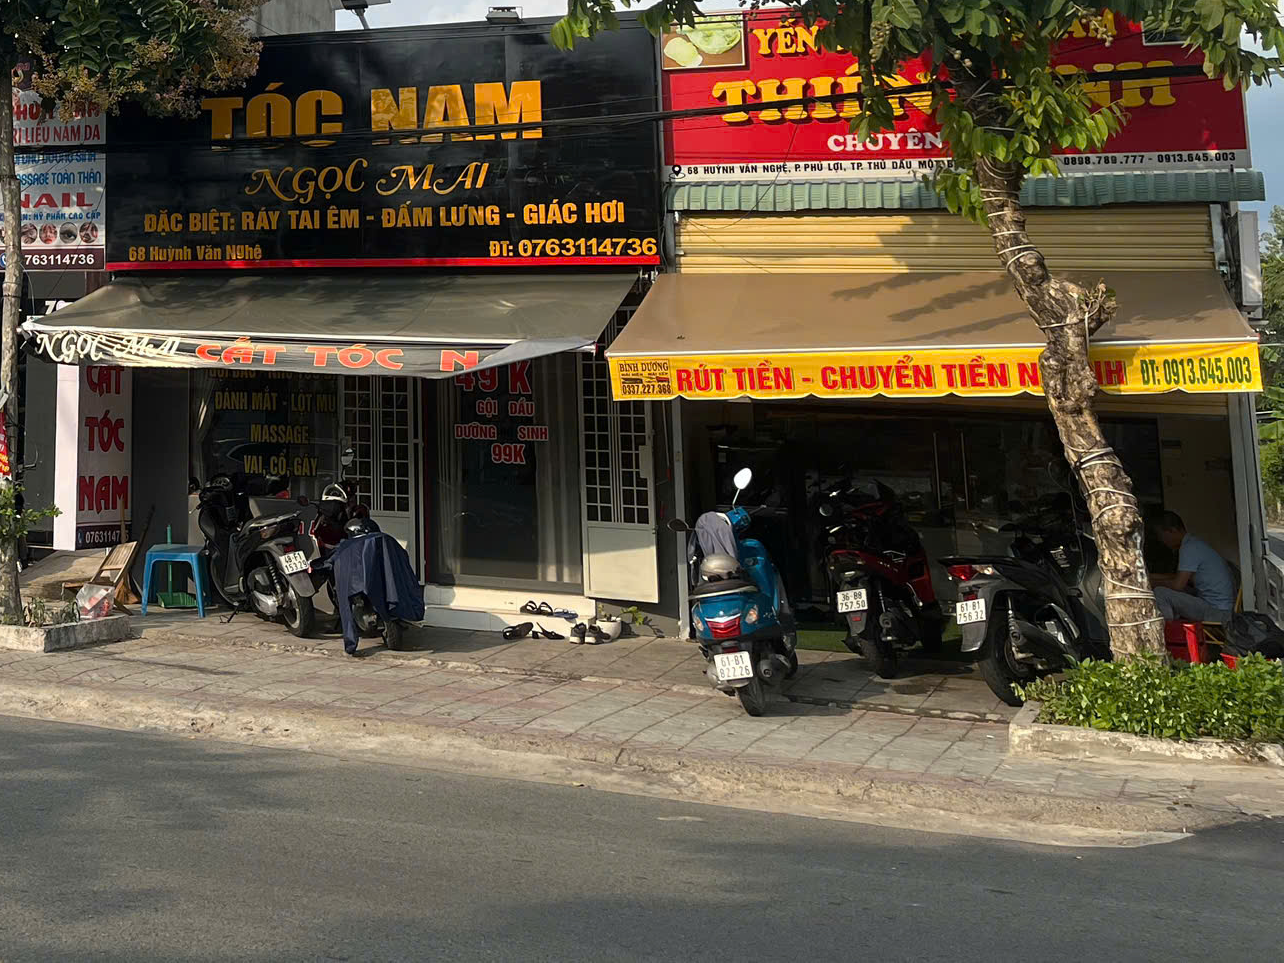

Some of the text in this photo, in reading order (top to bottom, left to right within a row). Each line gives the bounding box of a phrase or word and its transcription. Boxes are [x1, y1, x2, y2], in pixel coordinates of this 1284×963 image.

[202, 80, 543, 148] TÓC NAM
[84, 125, 101, 141] DA
[1157, 152, 1236, 163] 0913.645.003
[16, 172, 49, 186] ASSAGE
[51, 169, 75, 184] TOÀN
[687, 166, 699, 175] 68
[245, 158, 489, 204] NGỌC MAI
[68, 212, 83, 220] CAO
[144, 199, 625, 235] ĐẶC BIỆT: RÁY TAI ÊM ĐẤM LƯNG GIÁC HƠI
[129, 244, 262, 262] 68 Huỳnh Văn Nghệ
[489, 238, 657, 257] ĐT: 0763114736
[24, 253, 95, 265] 763114736
[305, 343, 404, 370] TÓC
[619, 360, 639, 372] BÌNH
[508, 359, 532, 394] K
[676, 364, 726, 392] RÚT
[732, 359, 794, 391] TIỀN
[821, 355, 935, 390] CHUYỂN
[941, 355, 1010, 388] TIỀN
[1140, 358, 1160, 386] ĐT:
[1163, 356, 1253, 386] 0913.645.003
[476, 397, 498, 417] GỘI
[85, 409, 124, 452] TÓC
[250, 424, 309, 444] MASSAGE
[518, 426, 548, 441] SINH
[491, 443, 525, 464] 99K
[78, 475, 128, 514] NAM
[85, 529, 129, 544] 076311476
